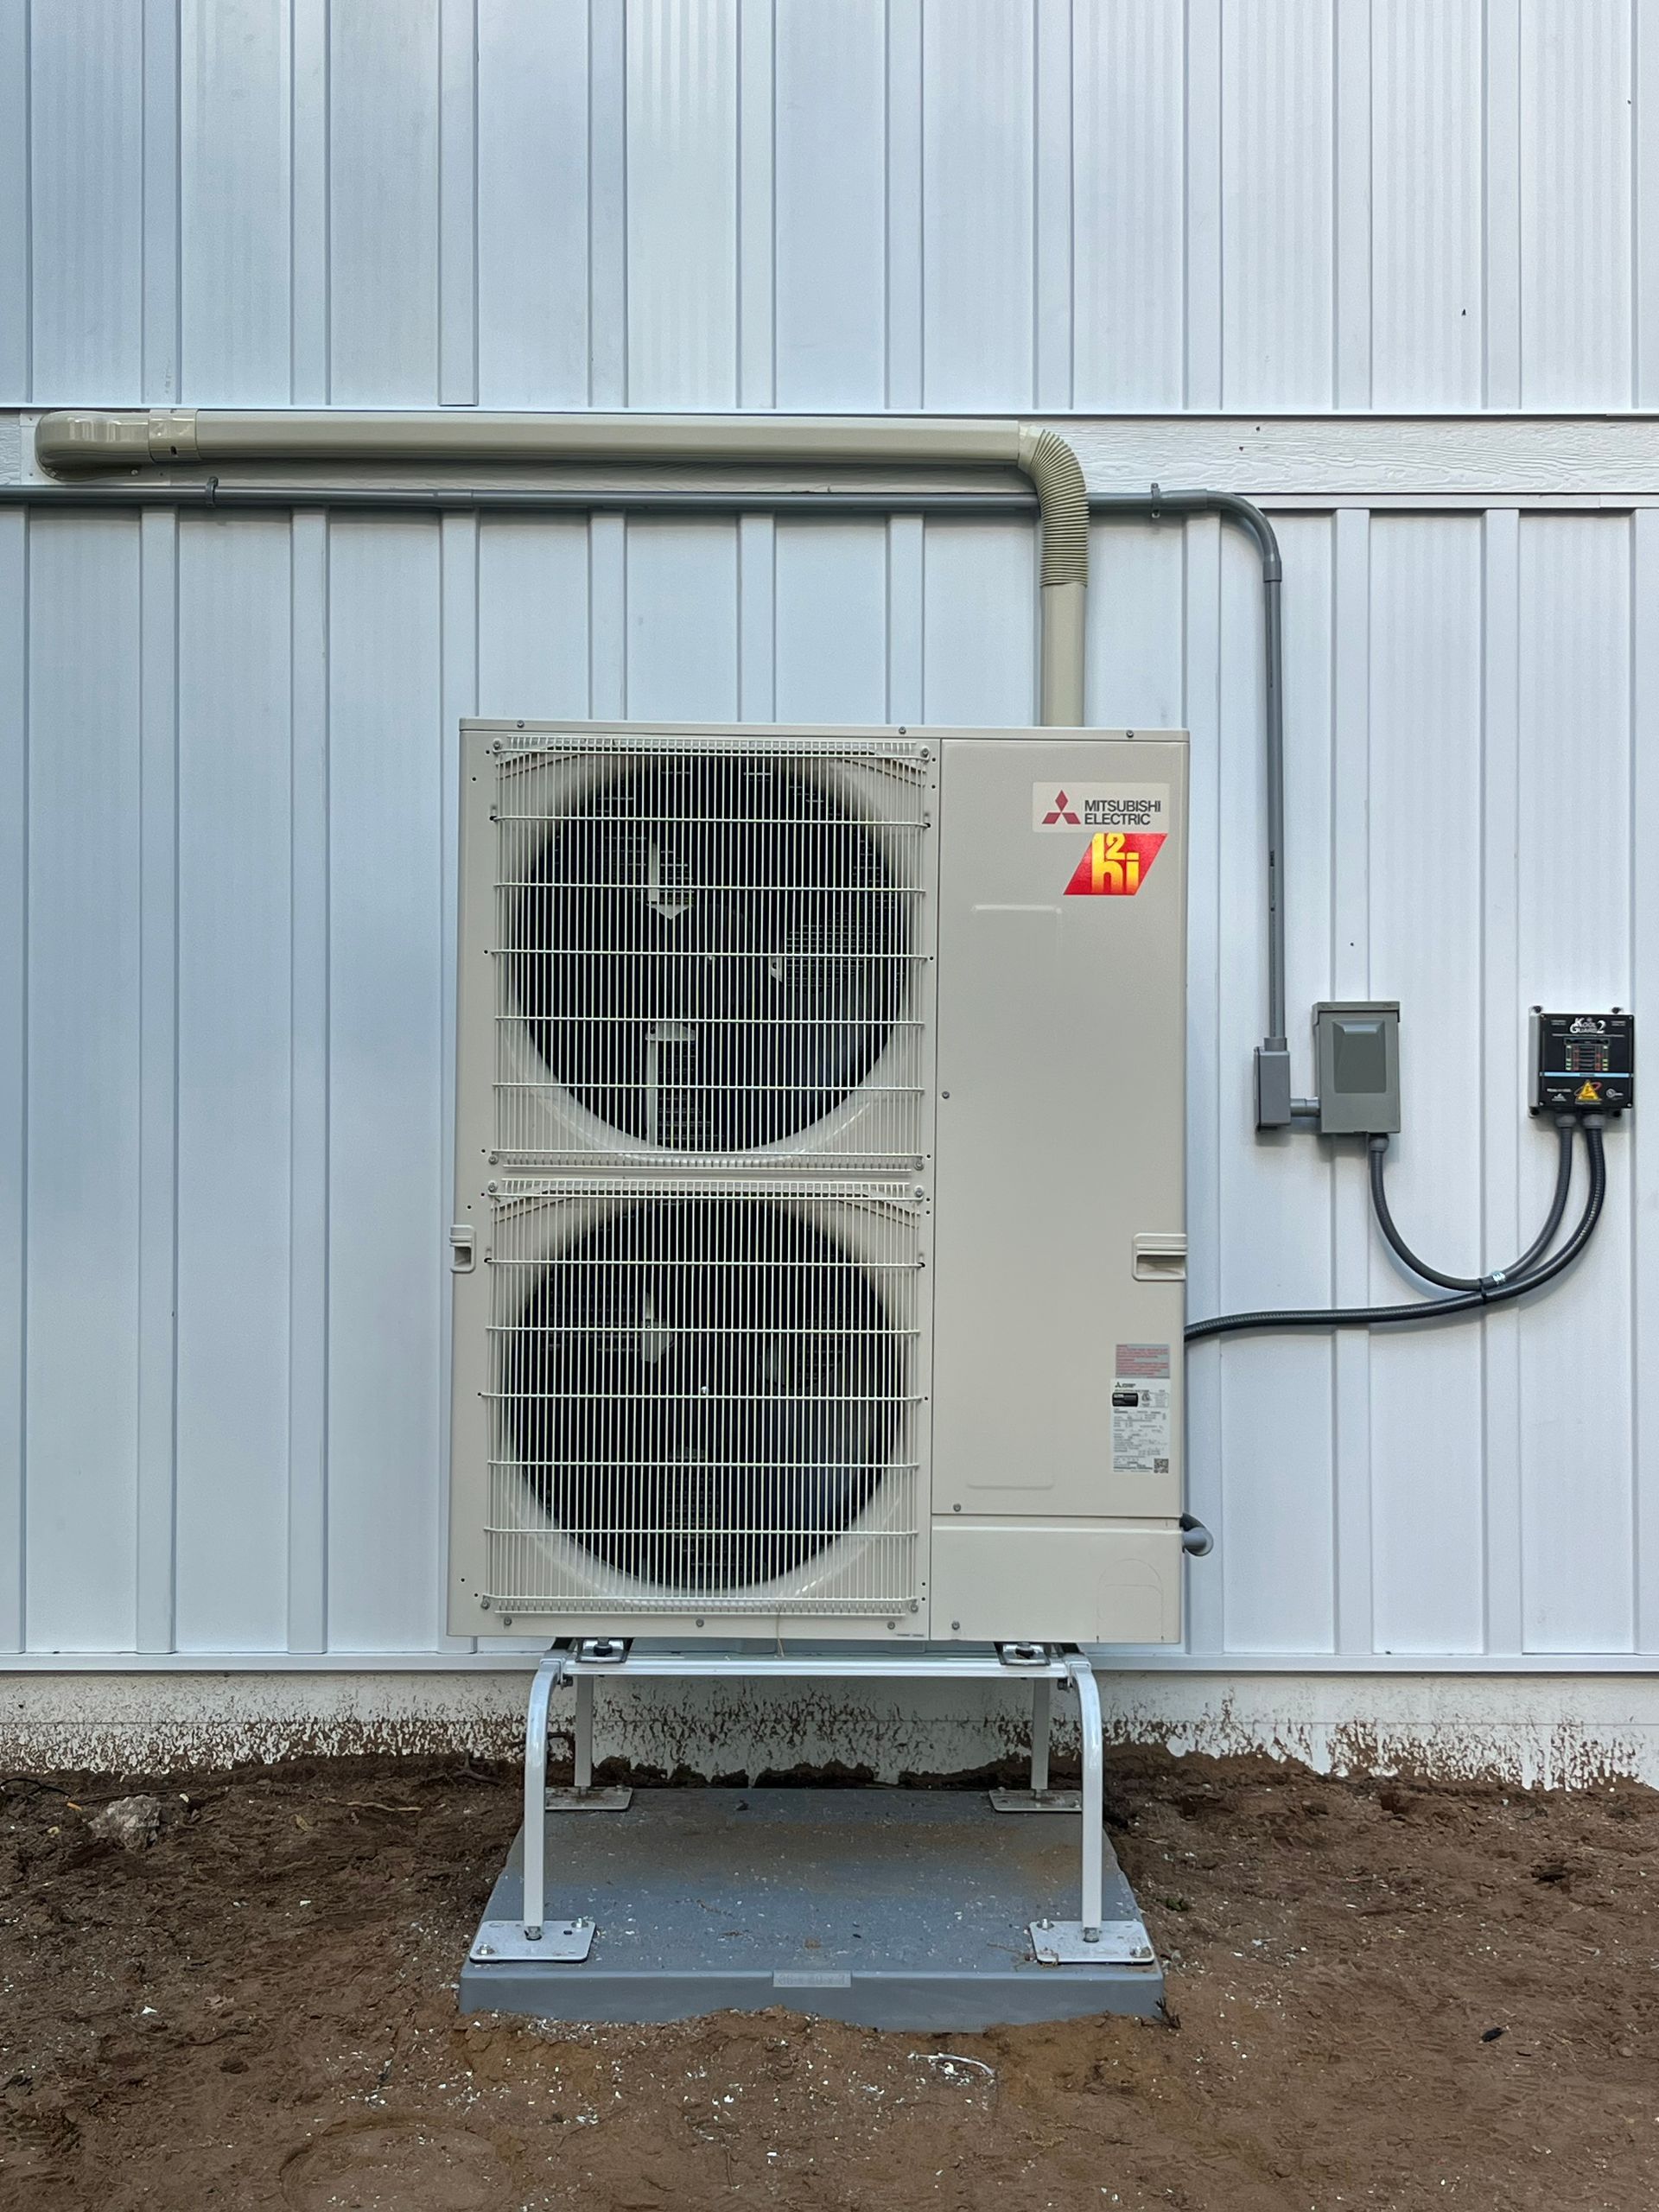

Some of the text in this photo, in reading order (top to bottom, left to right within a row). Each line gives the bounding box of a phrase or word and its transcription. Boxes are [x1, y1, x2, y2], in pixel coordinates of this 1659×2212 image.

[1084, 800, 1161, 812] MITSUBISHI
[1084, 813, 1151, 825] ELECTRIC
[1597, 1020, 1606, 1033] 2
